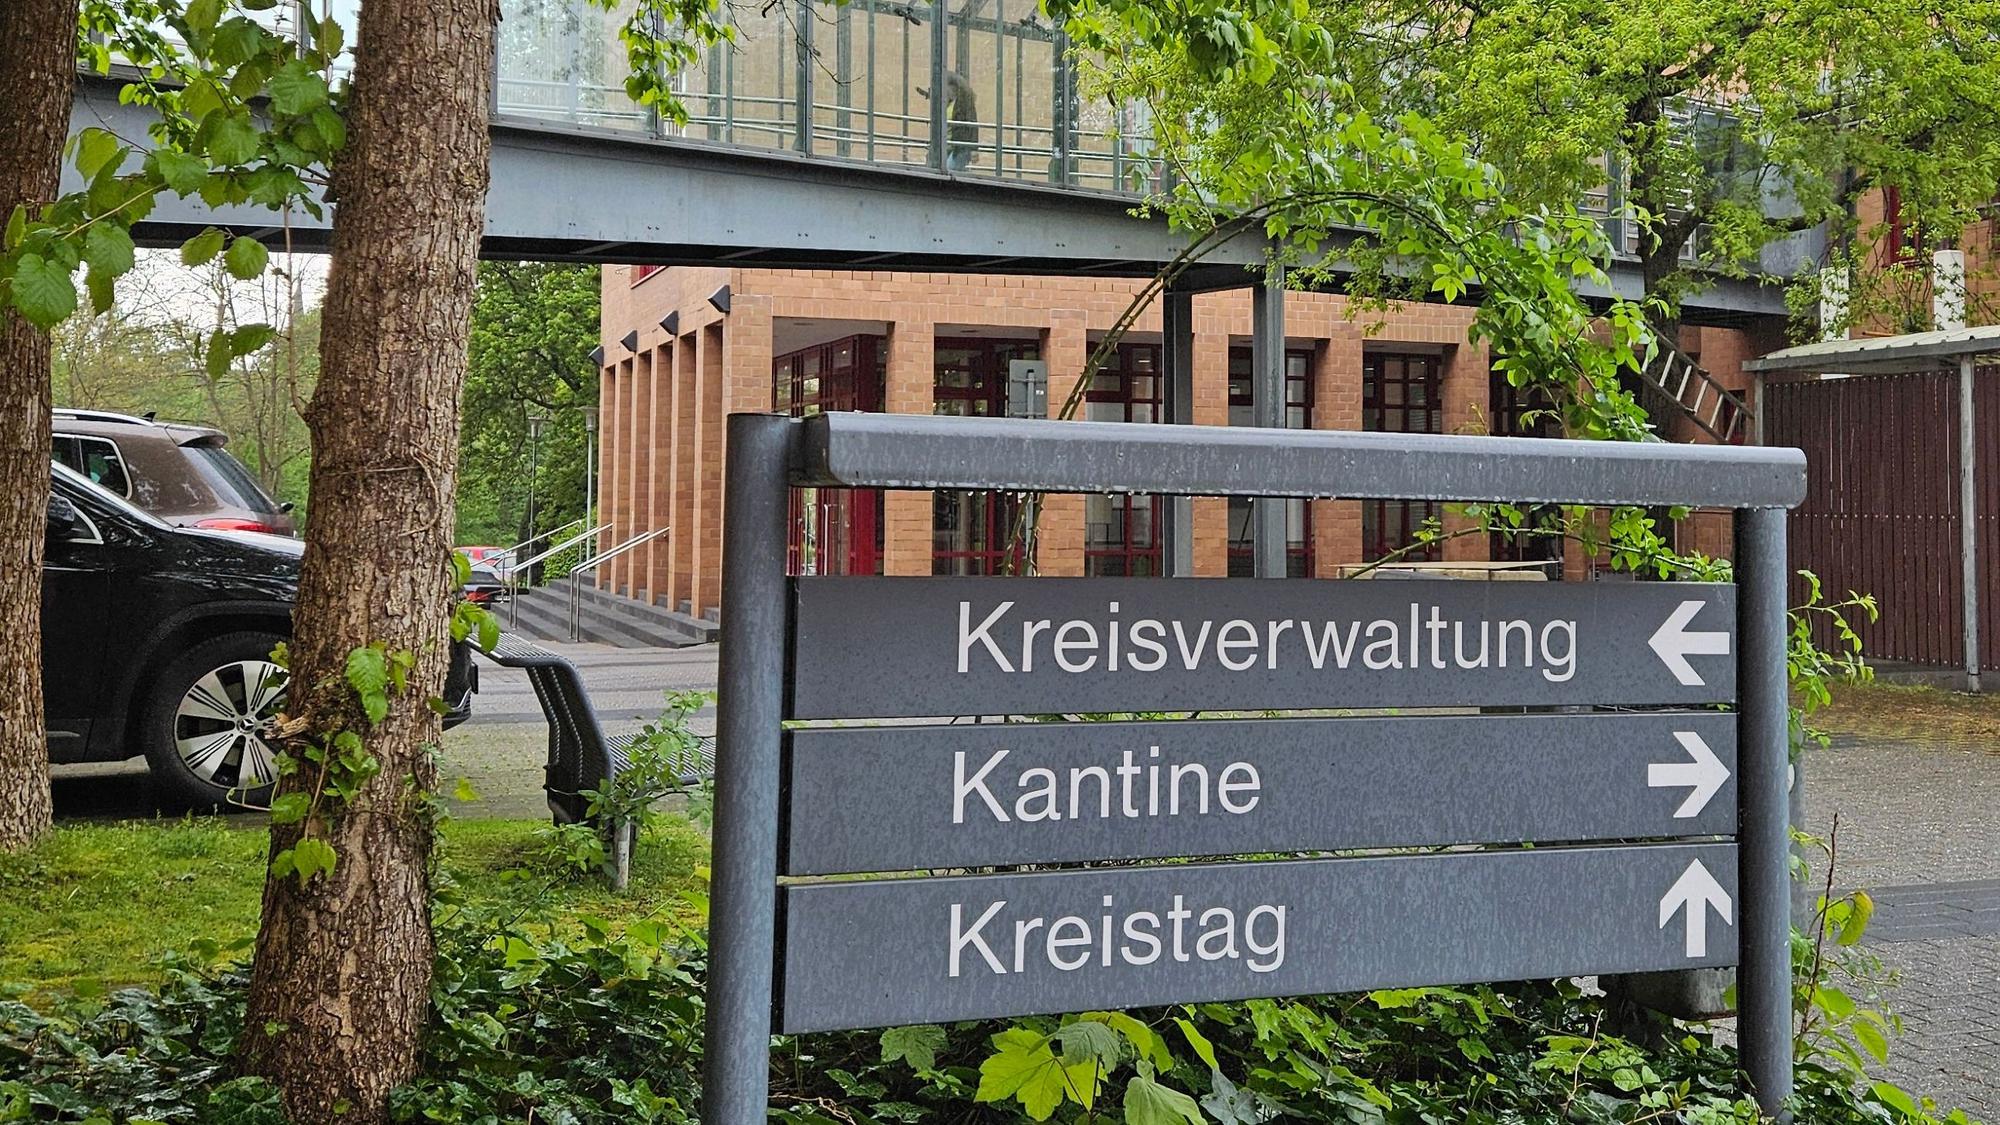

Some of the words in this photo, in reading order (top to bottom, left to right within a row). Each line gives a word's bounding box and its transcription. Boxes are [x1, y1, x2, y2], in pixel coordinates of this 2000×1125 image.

[957, 601, 1577, 683] Kreisverwaltung
[952, 745, 1261, 825] Kantine
[948, 894, 1287, 979] Kreistag
